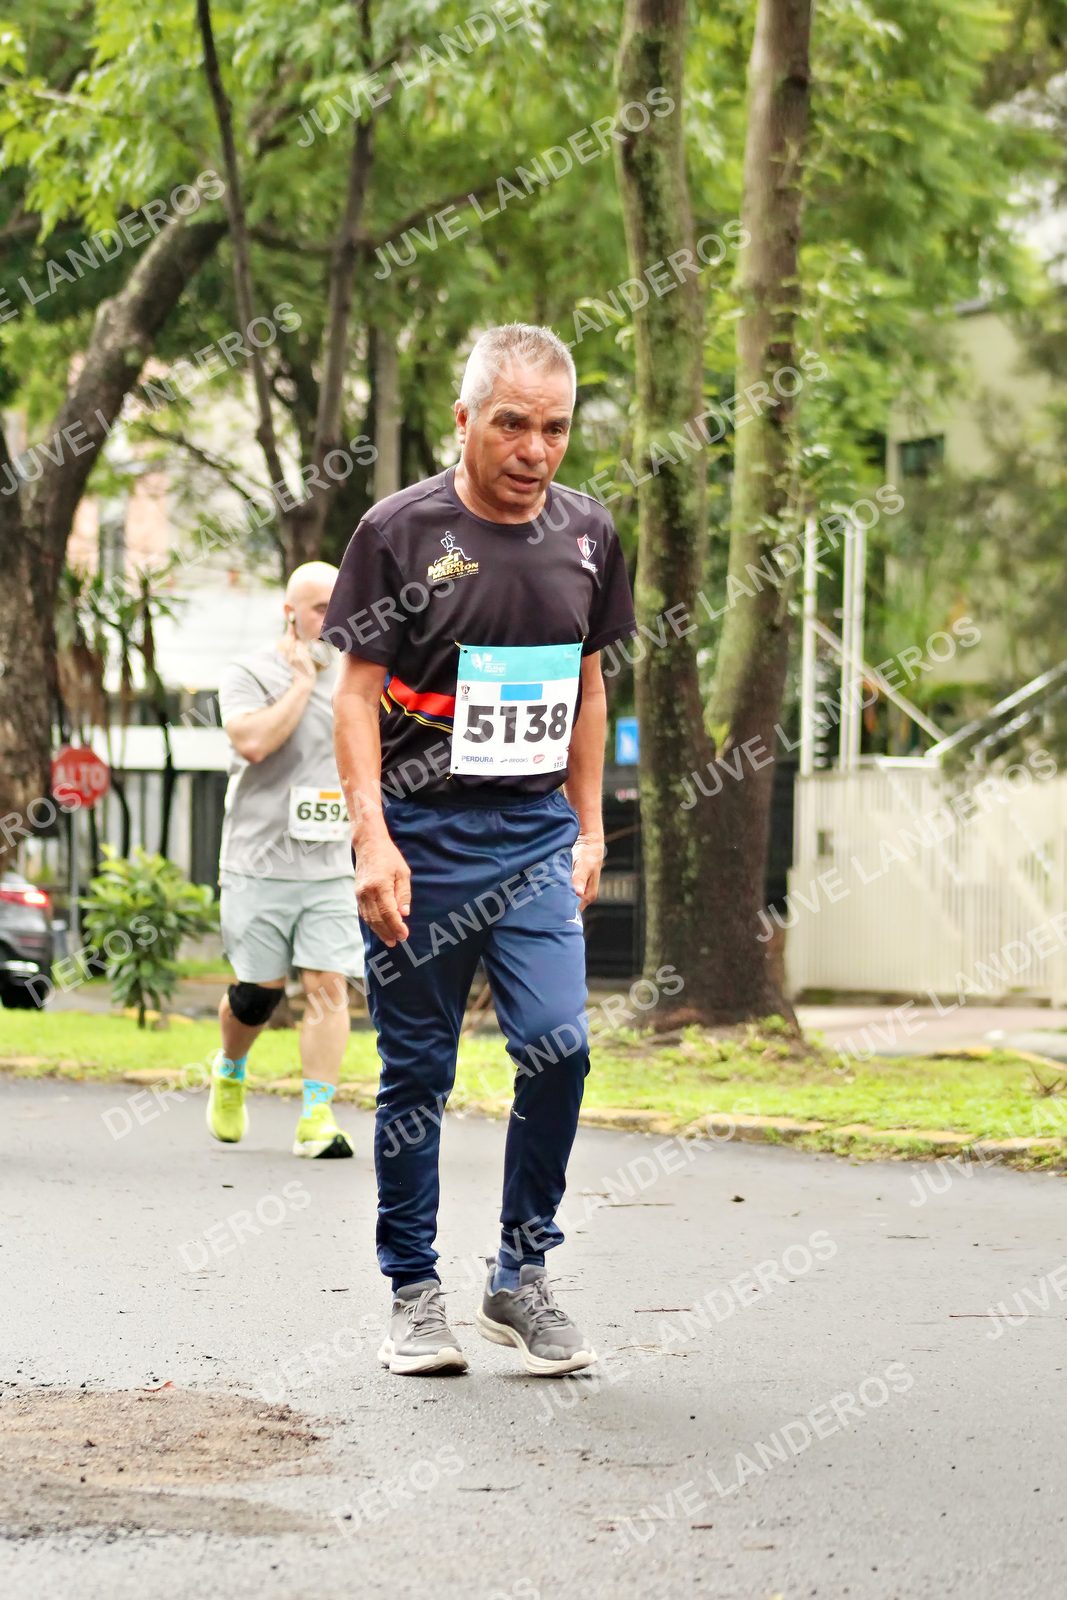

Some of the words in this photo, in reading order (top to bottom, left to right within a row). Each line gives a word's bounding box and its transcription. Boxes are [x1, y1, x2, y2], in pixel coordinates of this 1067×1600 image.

[463, 703, 568, 744] 5138
[461, 755, 494, 764] PERDURA
[55, 763, 108, 795] ALTO
